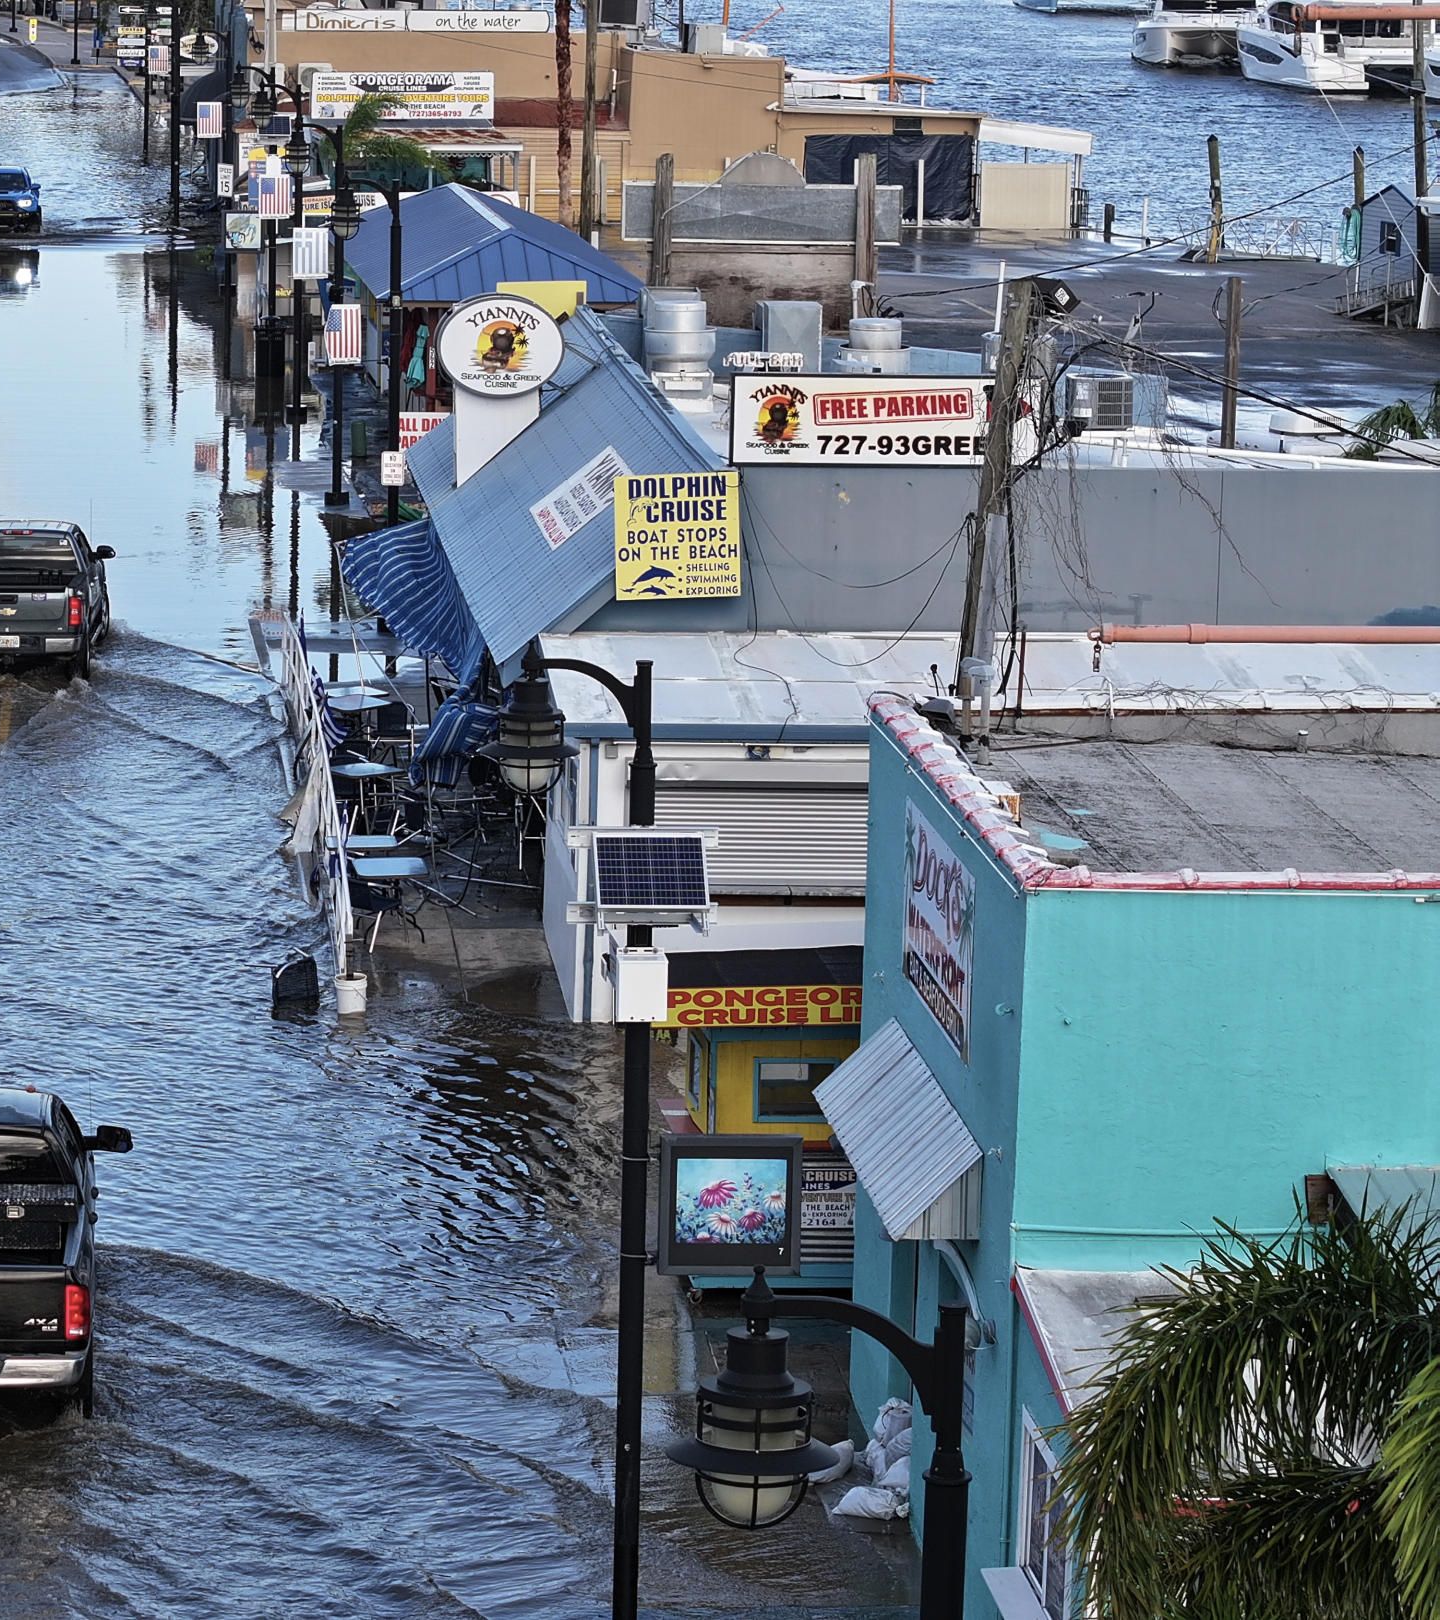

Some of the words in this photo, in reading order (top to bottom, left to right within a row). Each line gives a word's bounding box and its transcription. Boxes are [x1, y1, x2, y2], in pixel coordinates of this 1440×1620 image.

[435, 17, 457, 29] on
[457, 13, 481, 30] the
[483, 16, 521, 29] water
[350, 73, 456, 86] SPONGEORAMA
[317, 94, 360, 102] DOLPHIN
[457, 94, 489, 102] TOURS
[220, 180, 230, 193] 15
[460, 372, 501, 381] SEAFOOD
[503, 373, 512, 381] &
[513, 373, 542, 381] GREEK
[484, 380, 518, 388] CUISINE
[820, 396, 869, 420] FREE
[873, 393, 968, 418] PARKING
[399, 417, 418, 432] ALL
[816, 435, 987, 456] 727-93GREE
[628, 475, 727, 500] DOLPHIN
[646, 499, 727, 523] CRUISE
[627, 529, 668, 545] BOAT
[677, 526, 727, 543] STOPS
[618, 547, 641, 562] ON
[650, 545, 680, 561] THE
[689, 543, 738, 560] BEACH
[686, 562, 730, 572] SHELLING
[686, 574, 737, 583] SWIMMING
[686, 586, 738, 595] EXPLORING
[667, 987, 862, 1008] PONGEOR
[677, 1007, 809, 1025] CRUISE
[806, 1171, 856, 1182] CRUISE
[778, 1247, 784, 1255] 7
